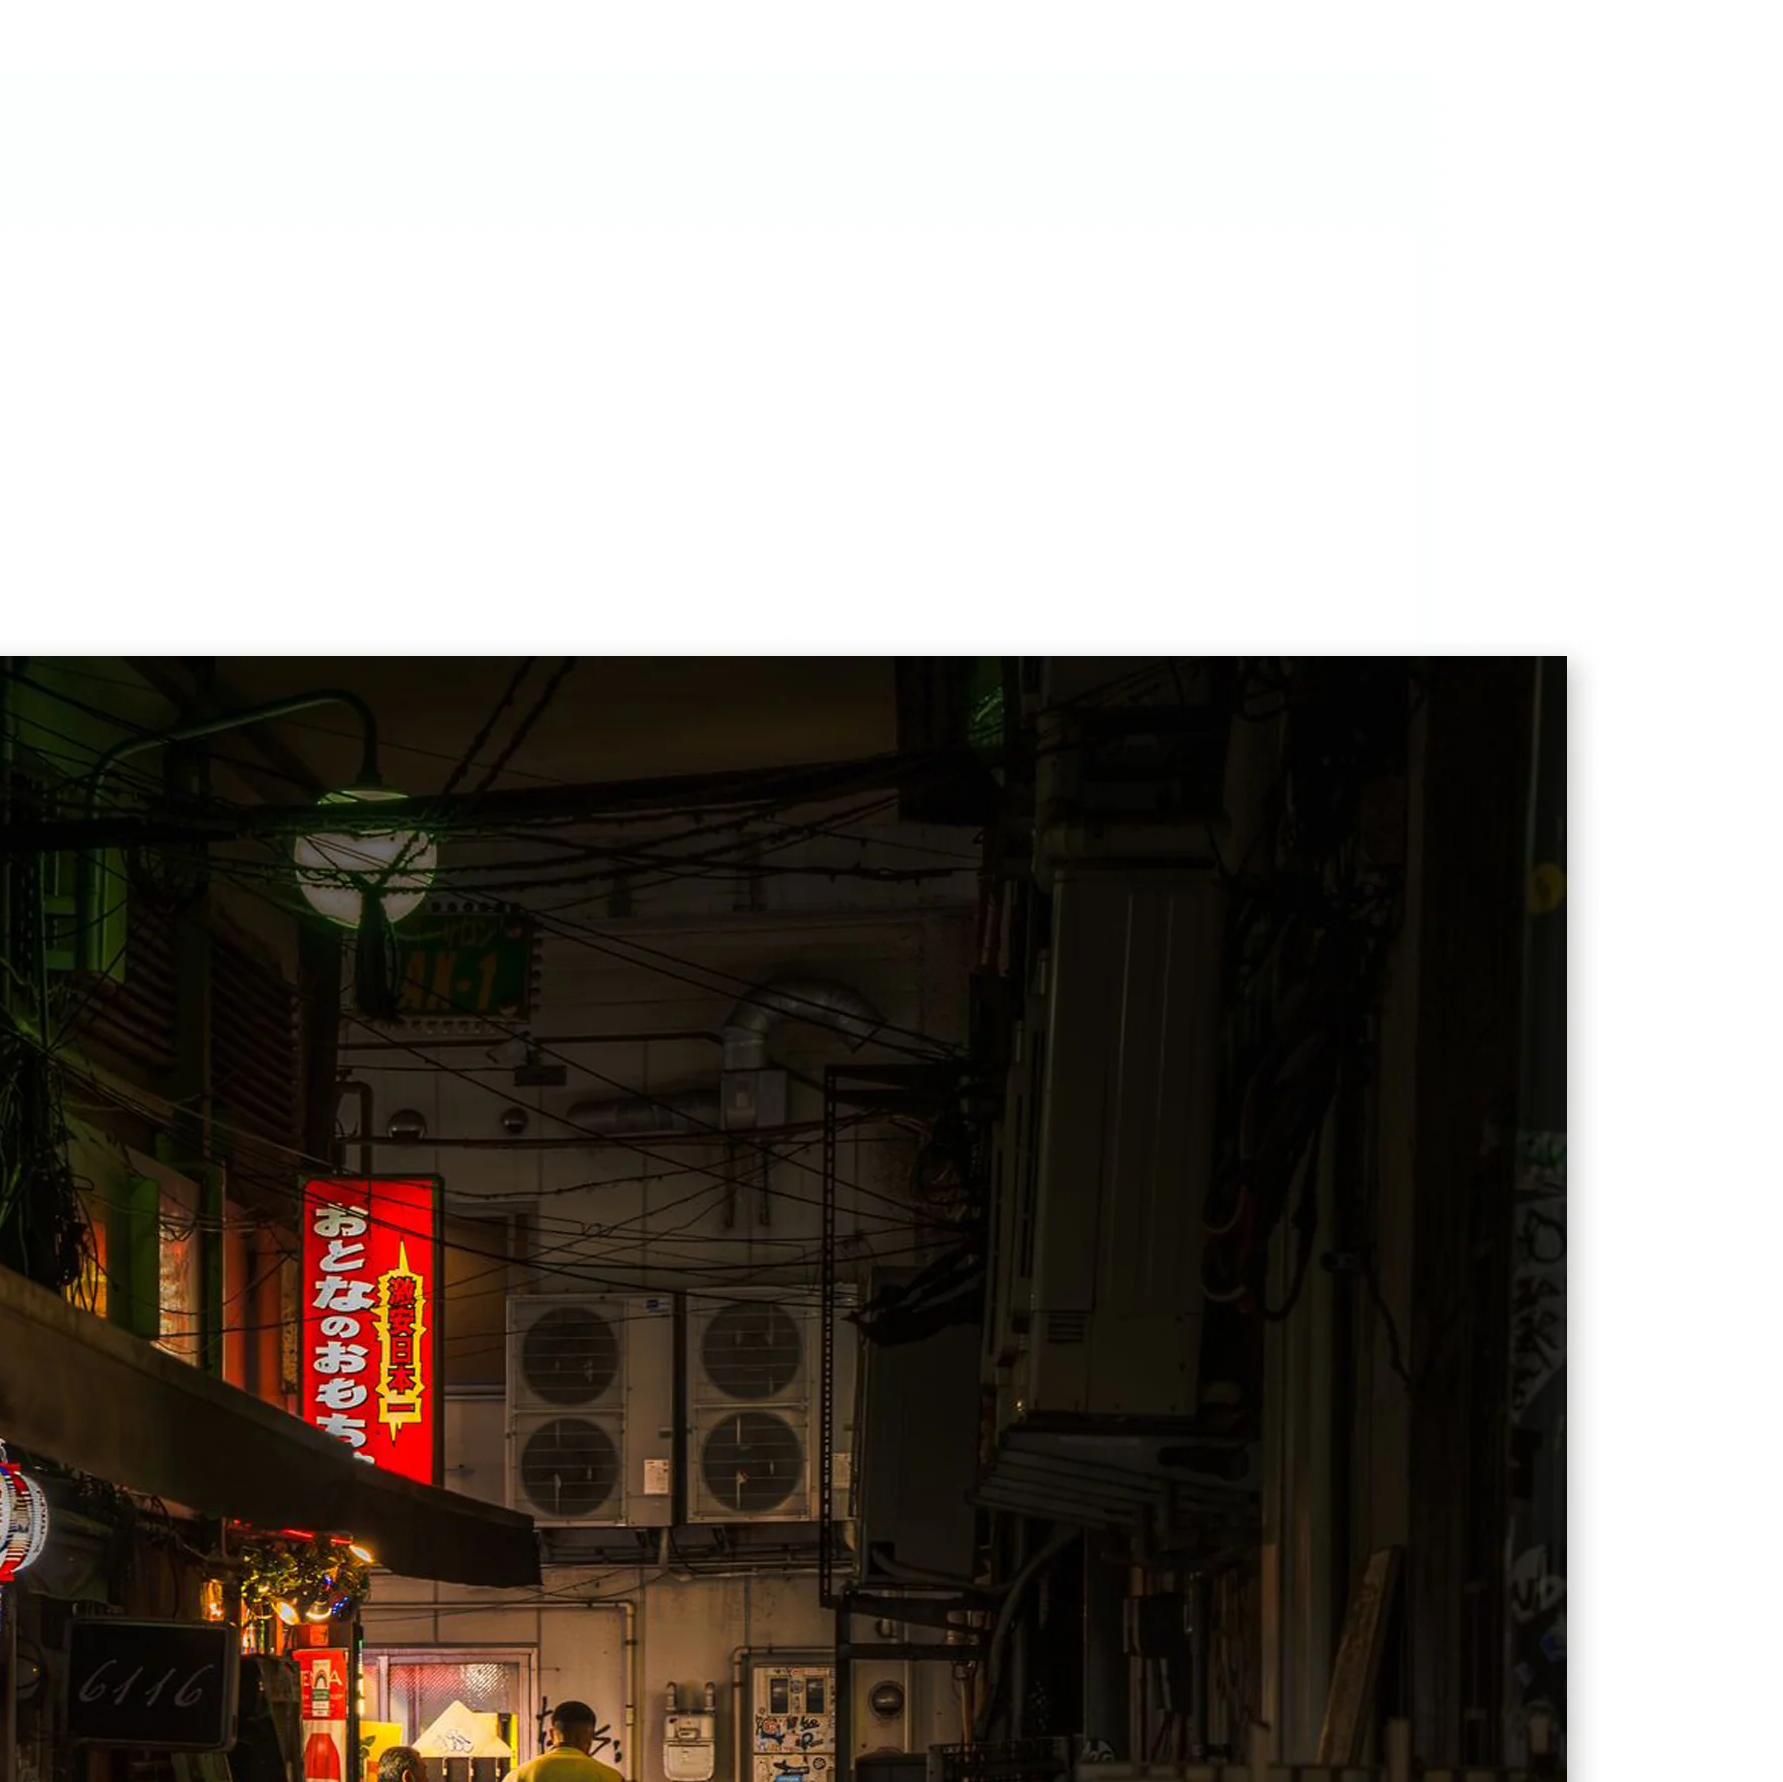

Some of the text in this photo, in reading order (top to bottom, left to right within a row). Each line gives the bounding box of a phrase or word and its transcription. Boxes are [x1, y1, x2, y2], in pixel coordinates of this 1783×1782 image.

[386, 1276, 416, 1413] 激安日本一
[78, 1658, 214, 1708] 6116
